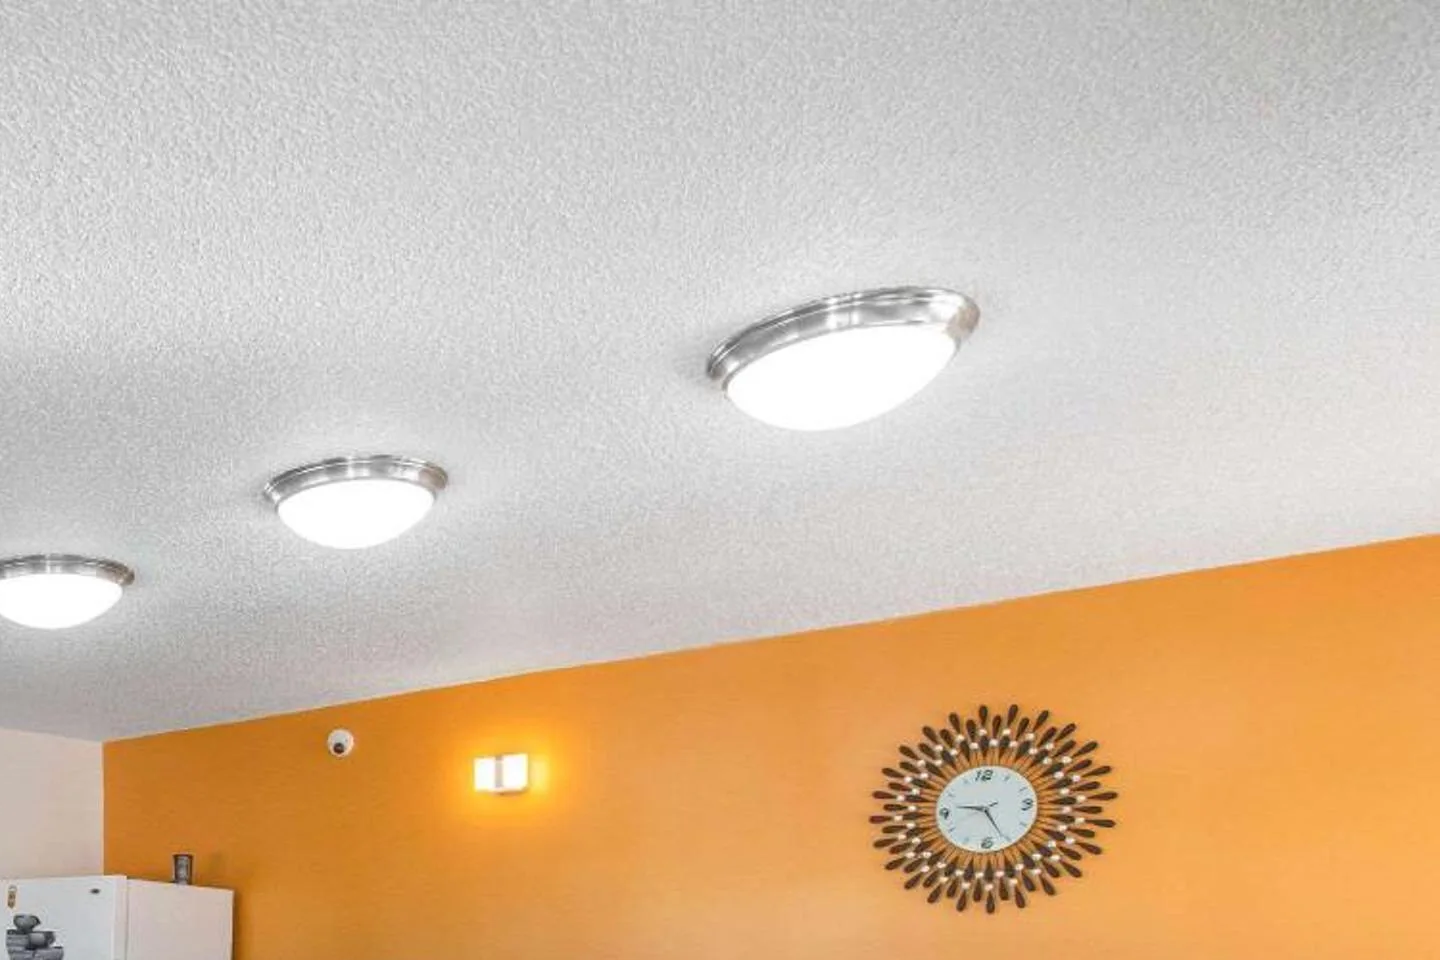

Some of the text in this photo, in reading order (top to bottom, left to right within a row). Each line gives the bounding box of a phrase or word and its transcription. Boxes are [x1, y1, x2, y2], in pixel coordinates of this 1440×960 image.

[975, 769, 993, 781] 12
[1021, 798, 1033, 811] 3
[939, 807, 950, 820] 9
[981, 837, 993, 849] 6
